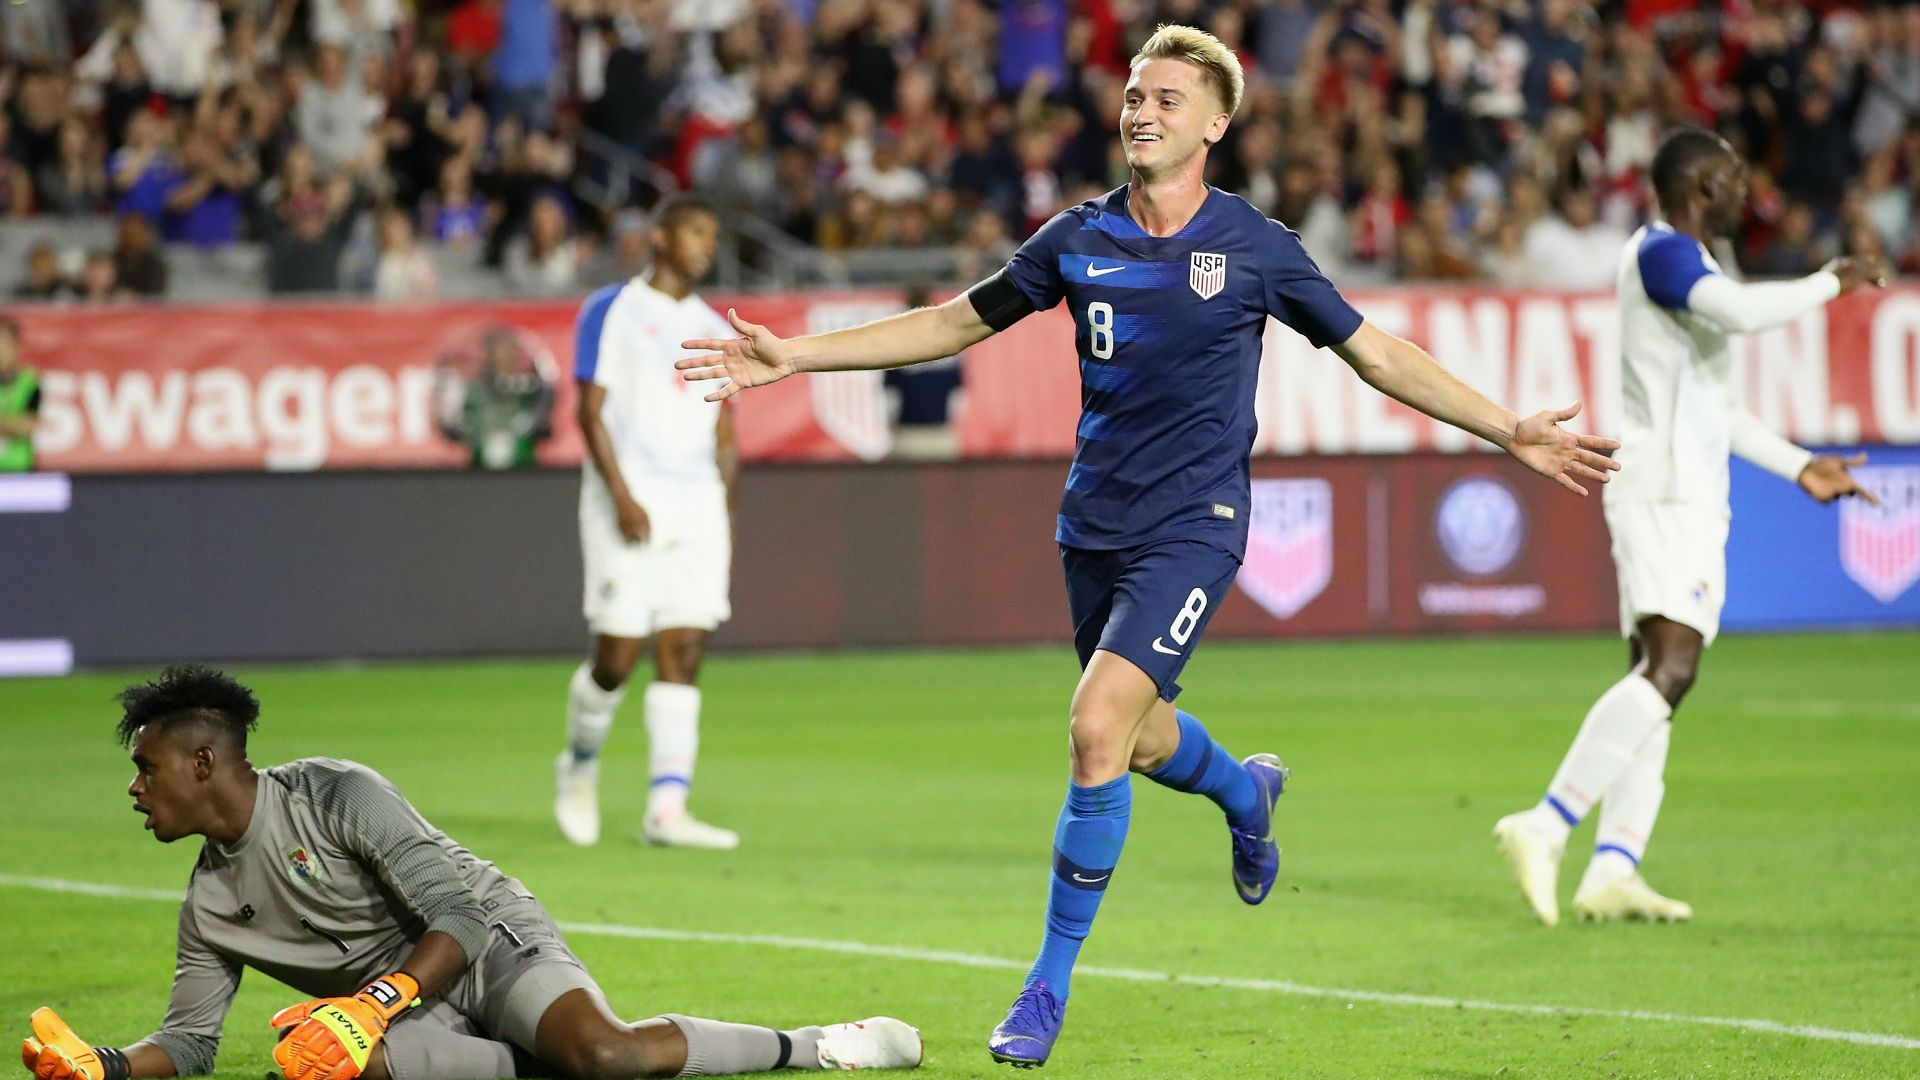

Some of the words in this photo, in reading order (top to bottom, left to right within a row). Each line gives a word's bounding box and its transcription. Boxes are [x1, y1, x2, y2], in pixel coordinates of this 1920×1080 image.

[1193, 254, 1223, 272] USA
[1087, 301, 1114, 360] 8
[1253, 298, 1415, 456] NE
[1425, 298, 1861, 456] NATN.
[1169, 586, 1208, 646] 8
[326, 1009, 369, 1051] RINAT
